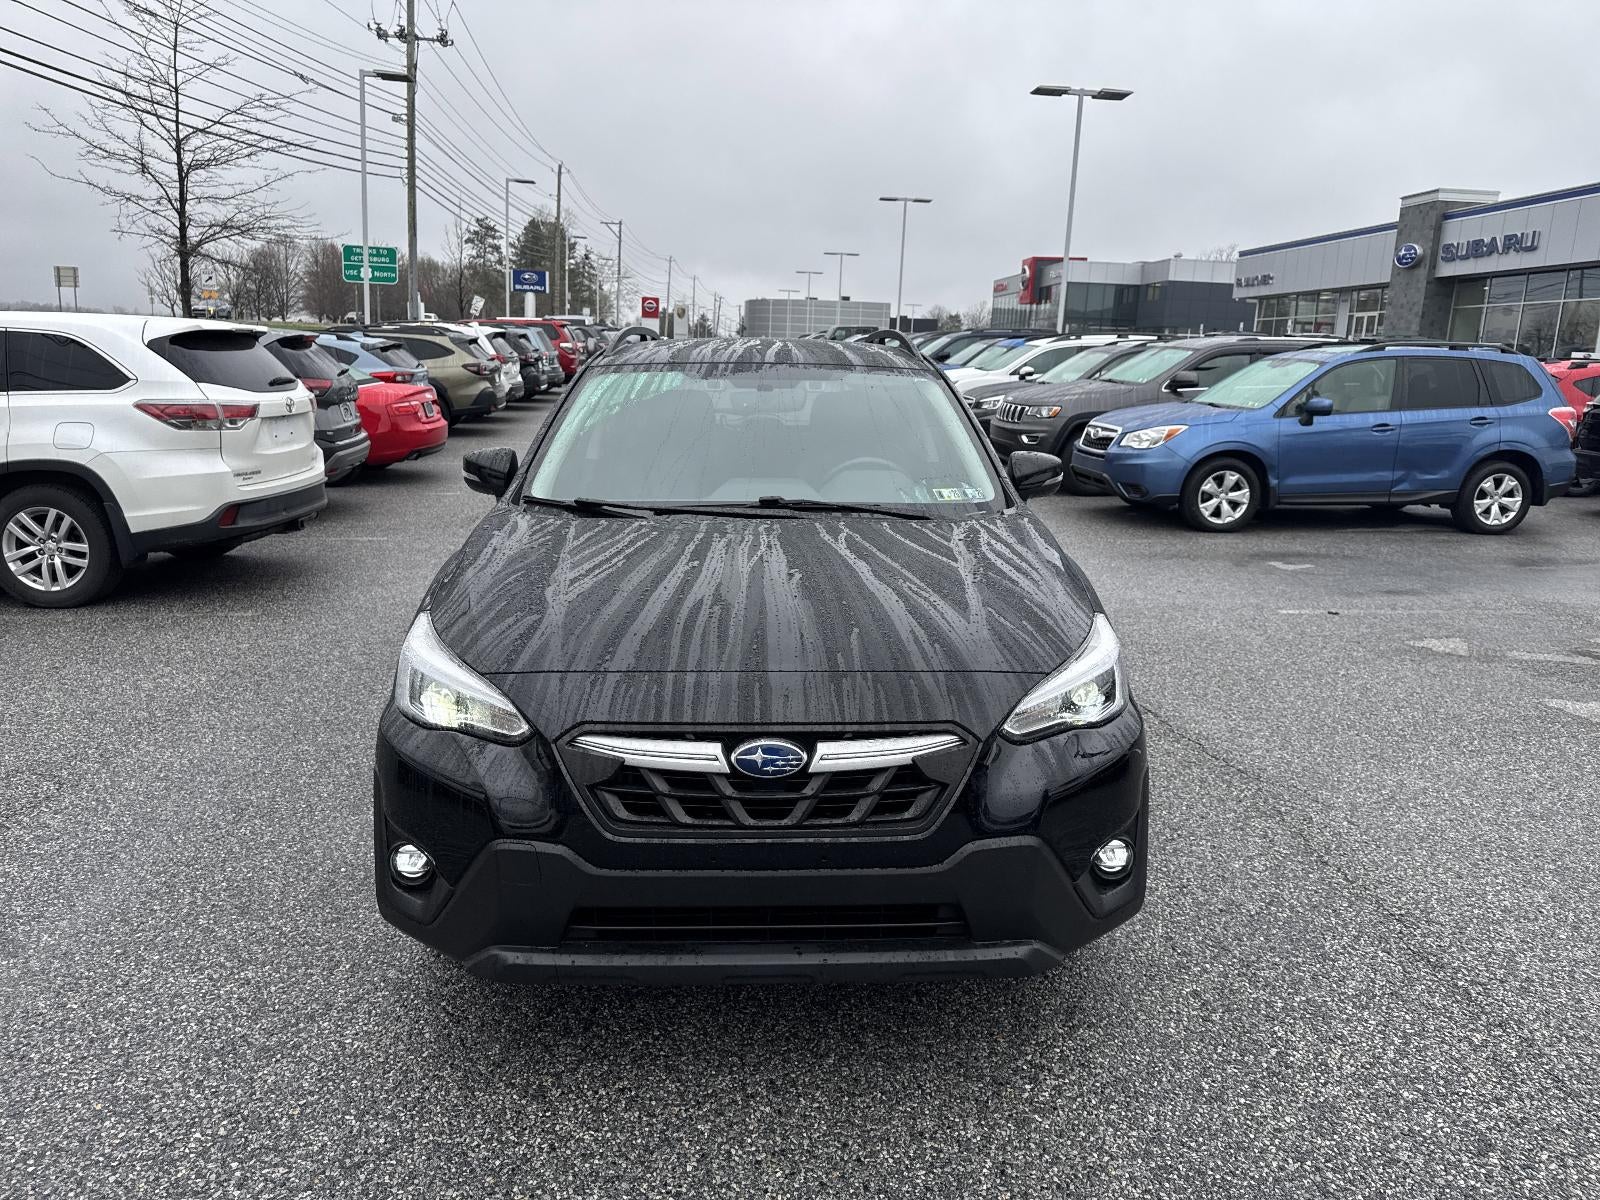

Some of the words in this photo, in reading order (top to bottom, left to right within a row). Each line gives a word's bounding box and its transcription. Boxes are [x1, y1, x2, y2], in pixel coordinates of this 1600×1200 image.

[1441, 230, 1540, 262] SUBARU
[350, 255, 390, 263] GETSBURG
[374, 270, 396, 278] NORTH
